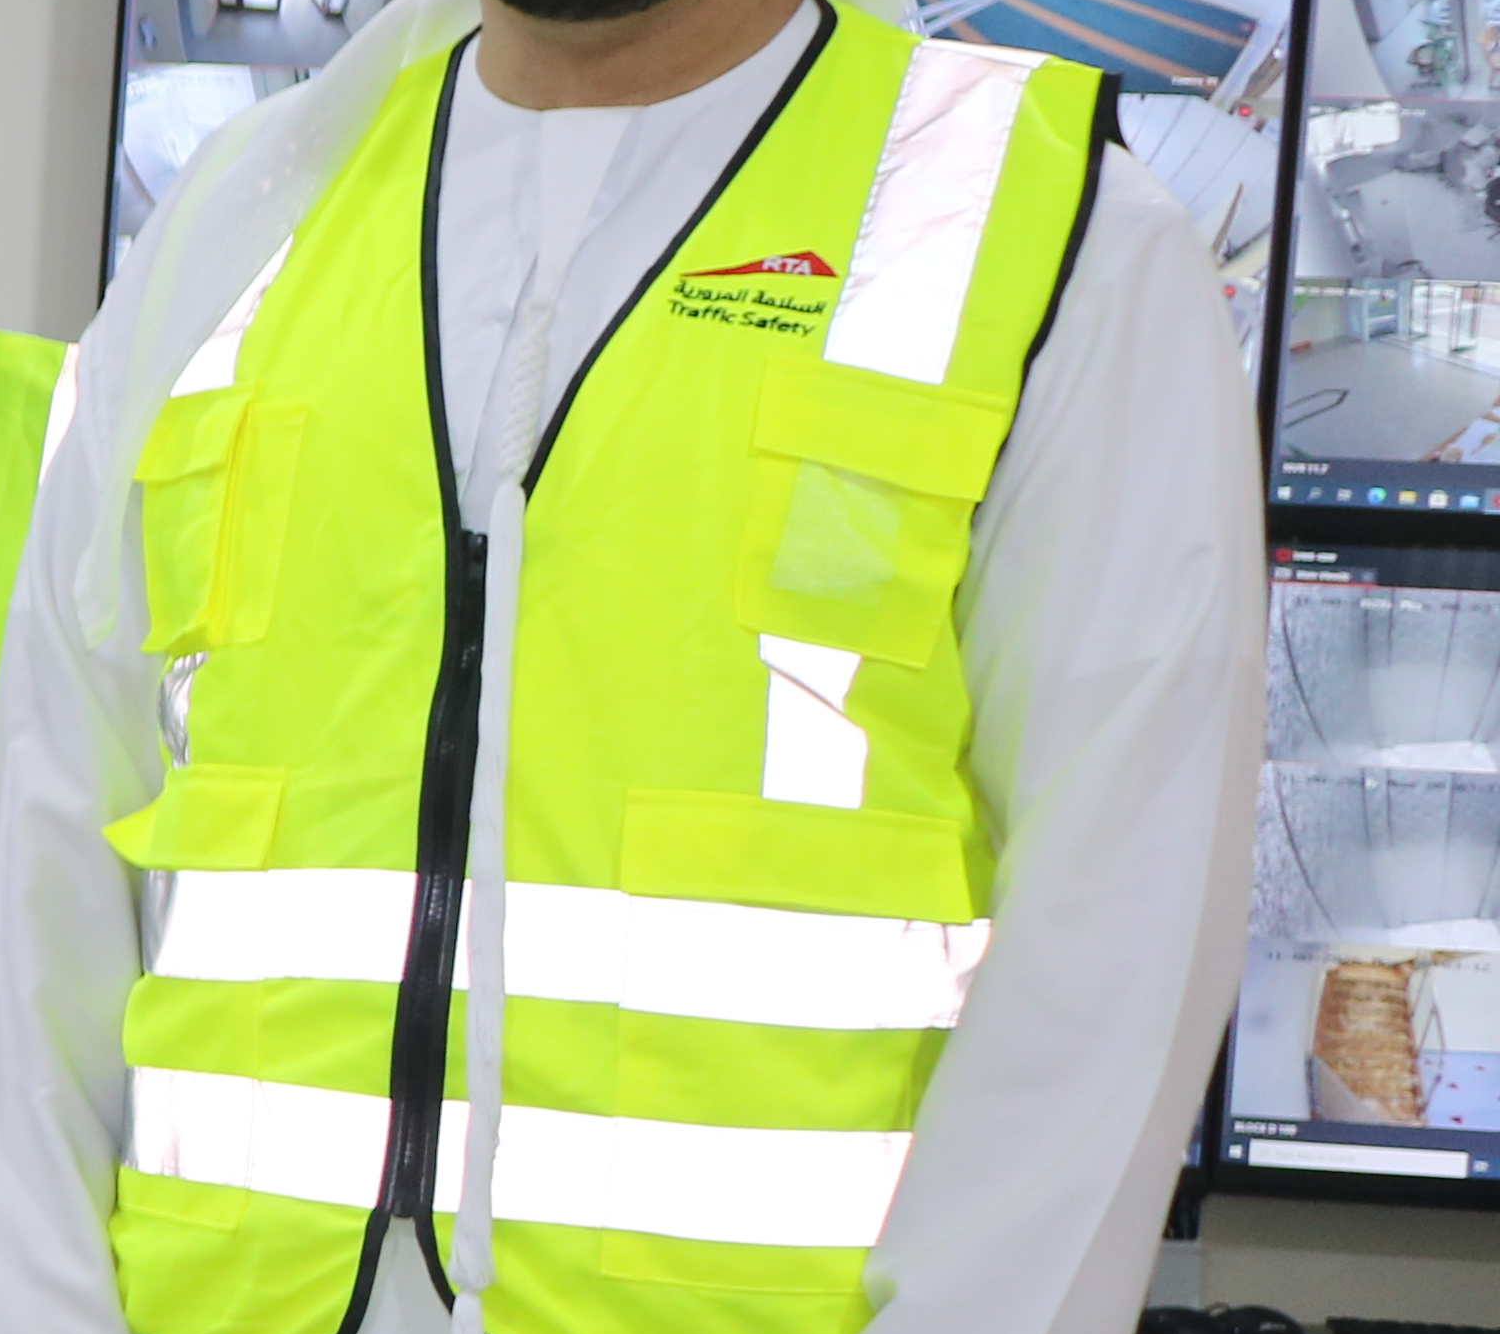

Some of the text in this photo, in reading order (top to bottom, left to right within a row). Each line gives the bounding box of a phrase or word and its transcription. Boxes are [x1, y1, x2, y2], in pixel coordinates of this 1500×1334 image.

[762, 256, 812, 276] RTA
[673, 279, 828, 315] السلامة المرورية
[669, 300, 816, 338] Traffic Safety
